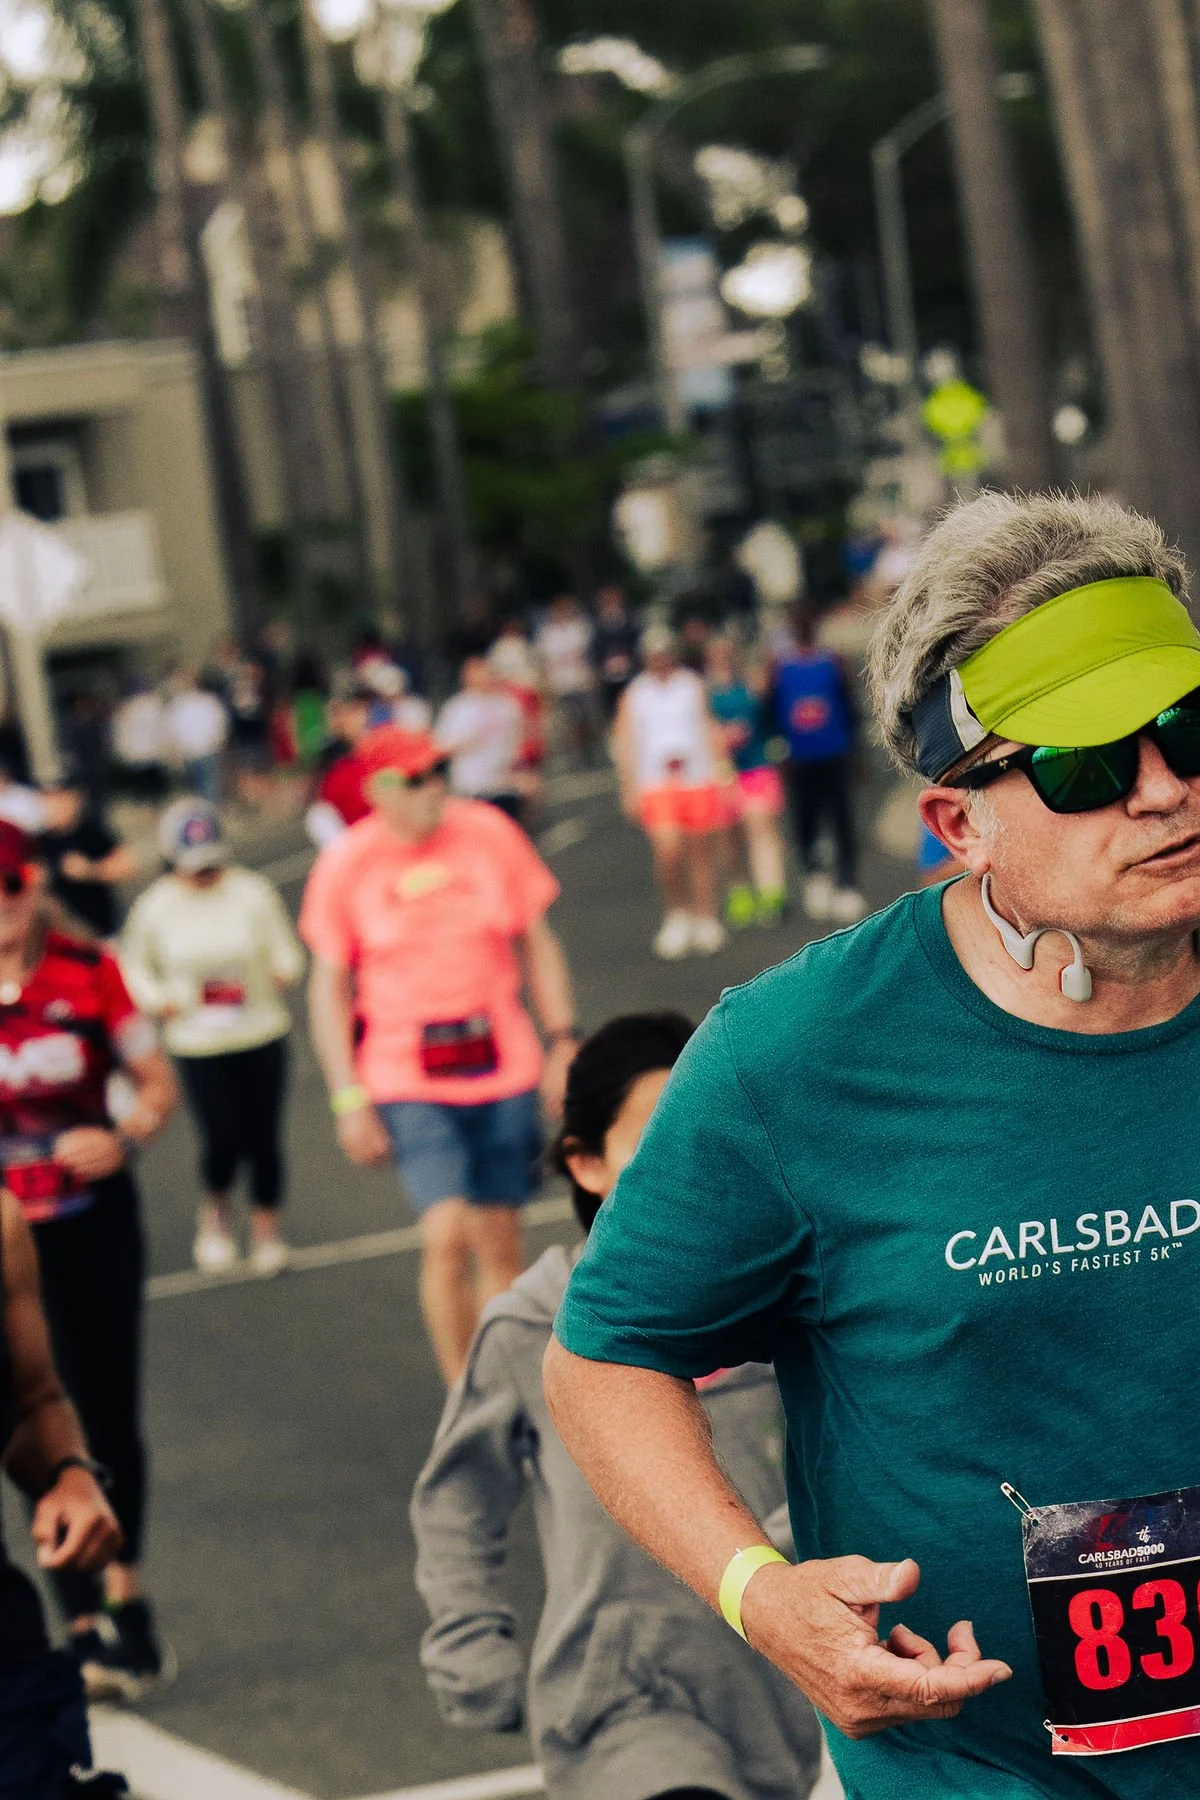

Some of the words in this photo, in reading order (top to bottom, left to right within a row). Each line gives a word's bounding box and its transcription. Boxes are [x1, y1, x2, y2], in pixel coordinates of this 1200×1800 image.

[978, 1260, 1062, 1287] WORLD'S
[1071, 1250, 1142, 1273] FASTEST
[1078, 1543, 1165, 1564] CARLSBAD5000
[1105, 1559, 1124, 1568] YEARS
[1135, 1556, 1150, 1564] FAST
